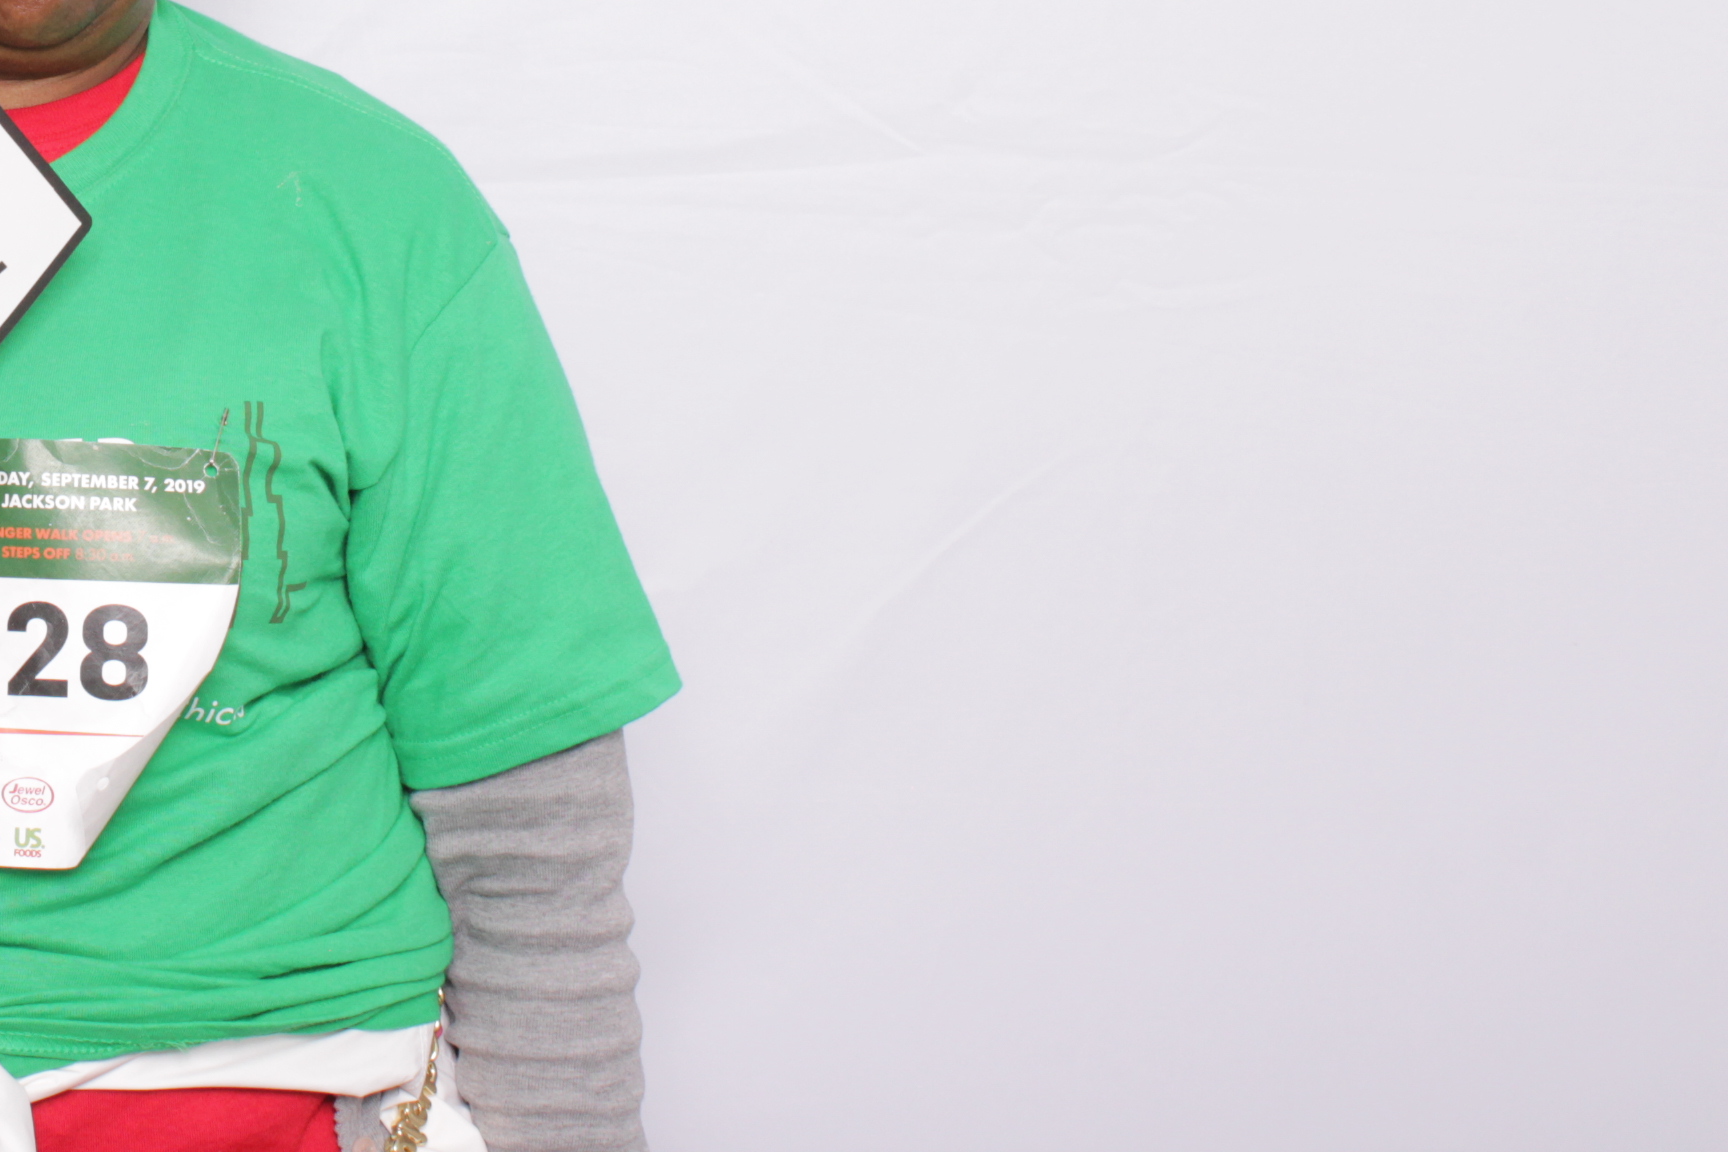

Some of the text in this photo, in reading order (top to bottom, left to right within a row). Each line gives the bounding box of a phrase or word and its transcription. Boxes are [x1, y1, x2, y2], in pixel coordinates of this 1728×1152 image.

[41, 472, 140, 491] SEPTEMBER
[143, 477, 158, 494] 7,
[163, 478, 206, 494] 2019
[1, 493, 137, 512] JACKSON PARK
[35, 528, 80, 542] WALK
[82, 528, 133, 543] OPENS
[1, 545, 41, 560] STEPS
[43, 547, 71, 560] OFF
[9, 783, 46, 795] Jewel
[13, 848, 42, 858] FOODS
